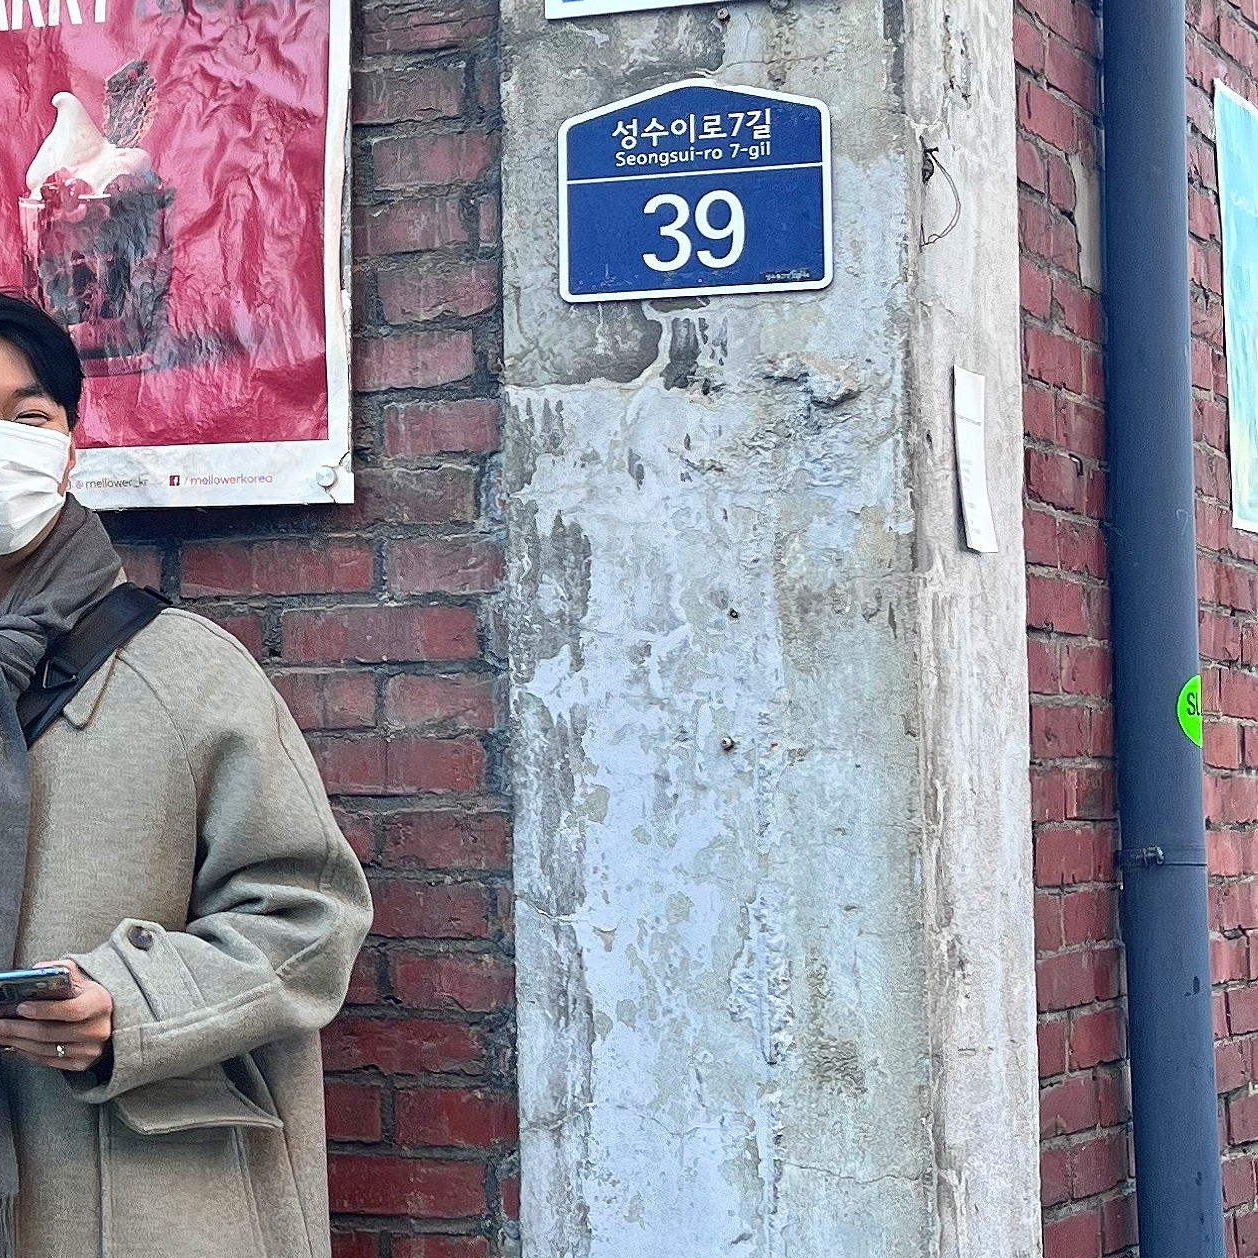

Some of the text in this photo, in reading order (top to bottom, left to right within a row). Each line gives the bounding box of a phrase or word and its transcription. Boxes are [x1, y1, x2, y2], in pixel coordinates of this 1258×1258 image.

[611, 107, 772, 150] 성수이로7길
[615, 141, 771, 167] Seongsui-ro 7-gil
[642, 189, 745, 272] 39
